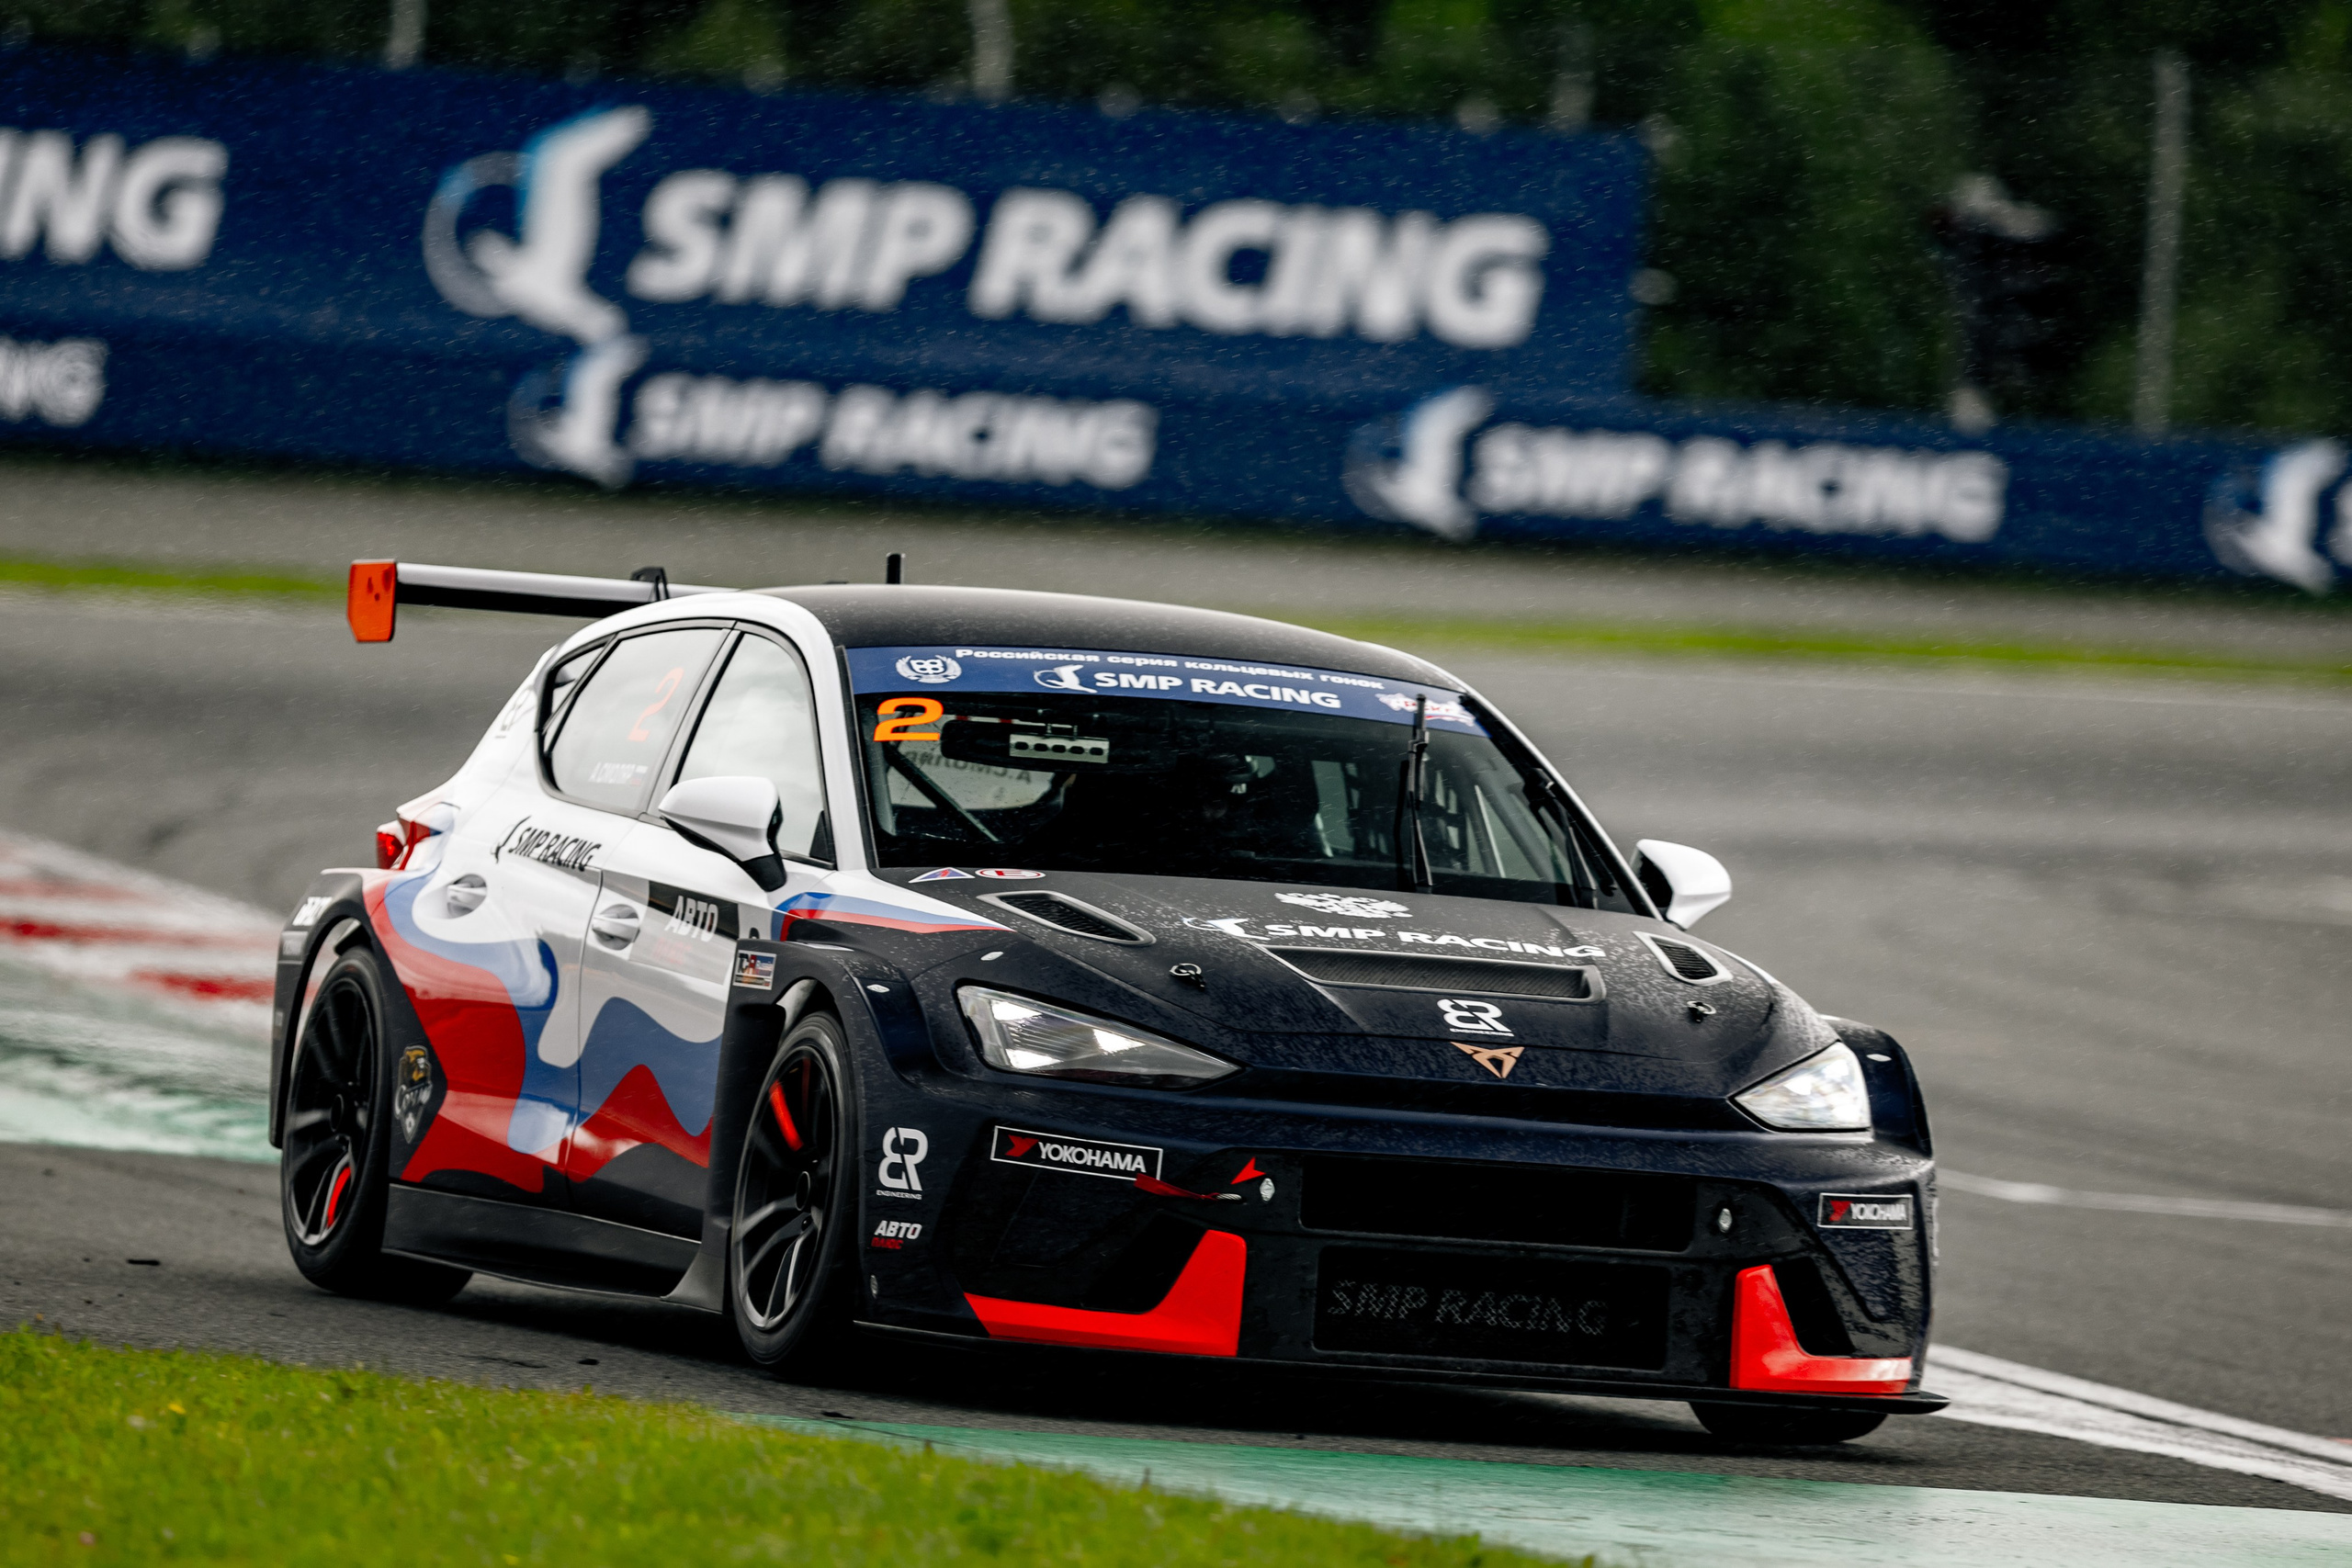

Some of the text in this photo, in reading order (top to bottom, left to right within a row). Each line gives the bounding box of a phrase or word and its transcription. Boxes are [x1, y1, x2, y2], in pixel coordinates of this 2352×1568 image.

[628, 171, 1549, 346] SMP RACING
[636, 375, 1156, 489] SMP RACING
[1476, 424, 2007, 542] SMP RACING
[956, 649, 1385, 689] Российская серия кольцевых гонок
[1093, 672, 1341, 709] SMP RACING
[628, 667, 684, 742] 2
[874, 697, 944, 742] 2
[508, 827, 602, 872] SMP RACING
[664, 895, 718, 942] АВТО
[1264, 923, 1606, 958] SMP RACING
[1038, 1142, 1147, 1173] YOKOHAMA
[874, 1220, 922, 1239] АВТО
[1328, 1280, 1607, 1335] SMP RACING
